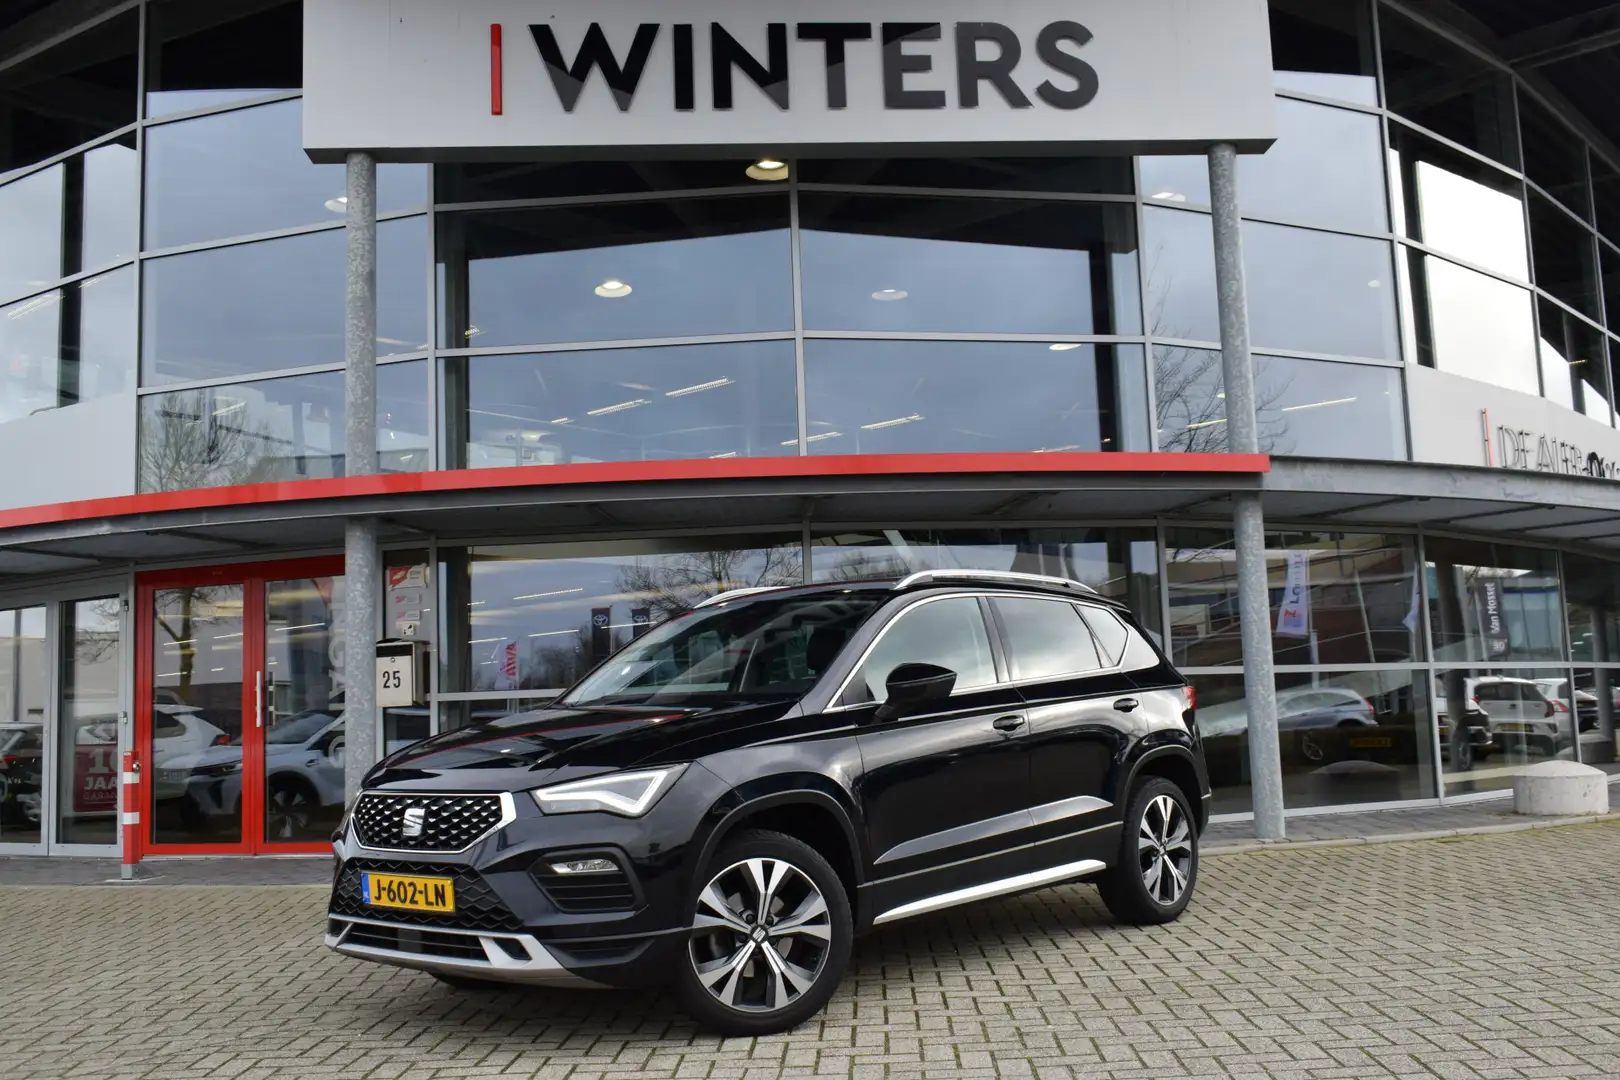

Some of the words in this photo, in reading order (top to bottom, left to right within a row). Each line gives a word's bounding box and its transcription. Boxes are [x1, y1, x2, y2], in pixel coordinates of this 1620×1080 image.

[528, 20, 1100, 112] WINTERS
[382, 670, 401, 689] 25
[374, 879, 446, 907] J-602-LN
